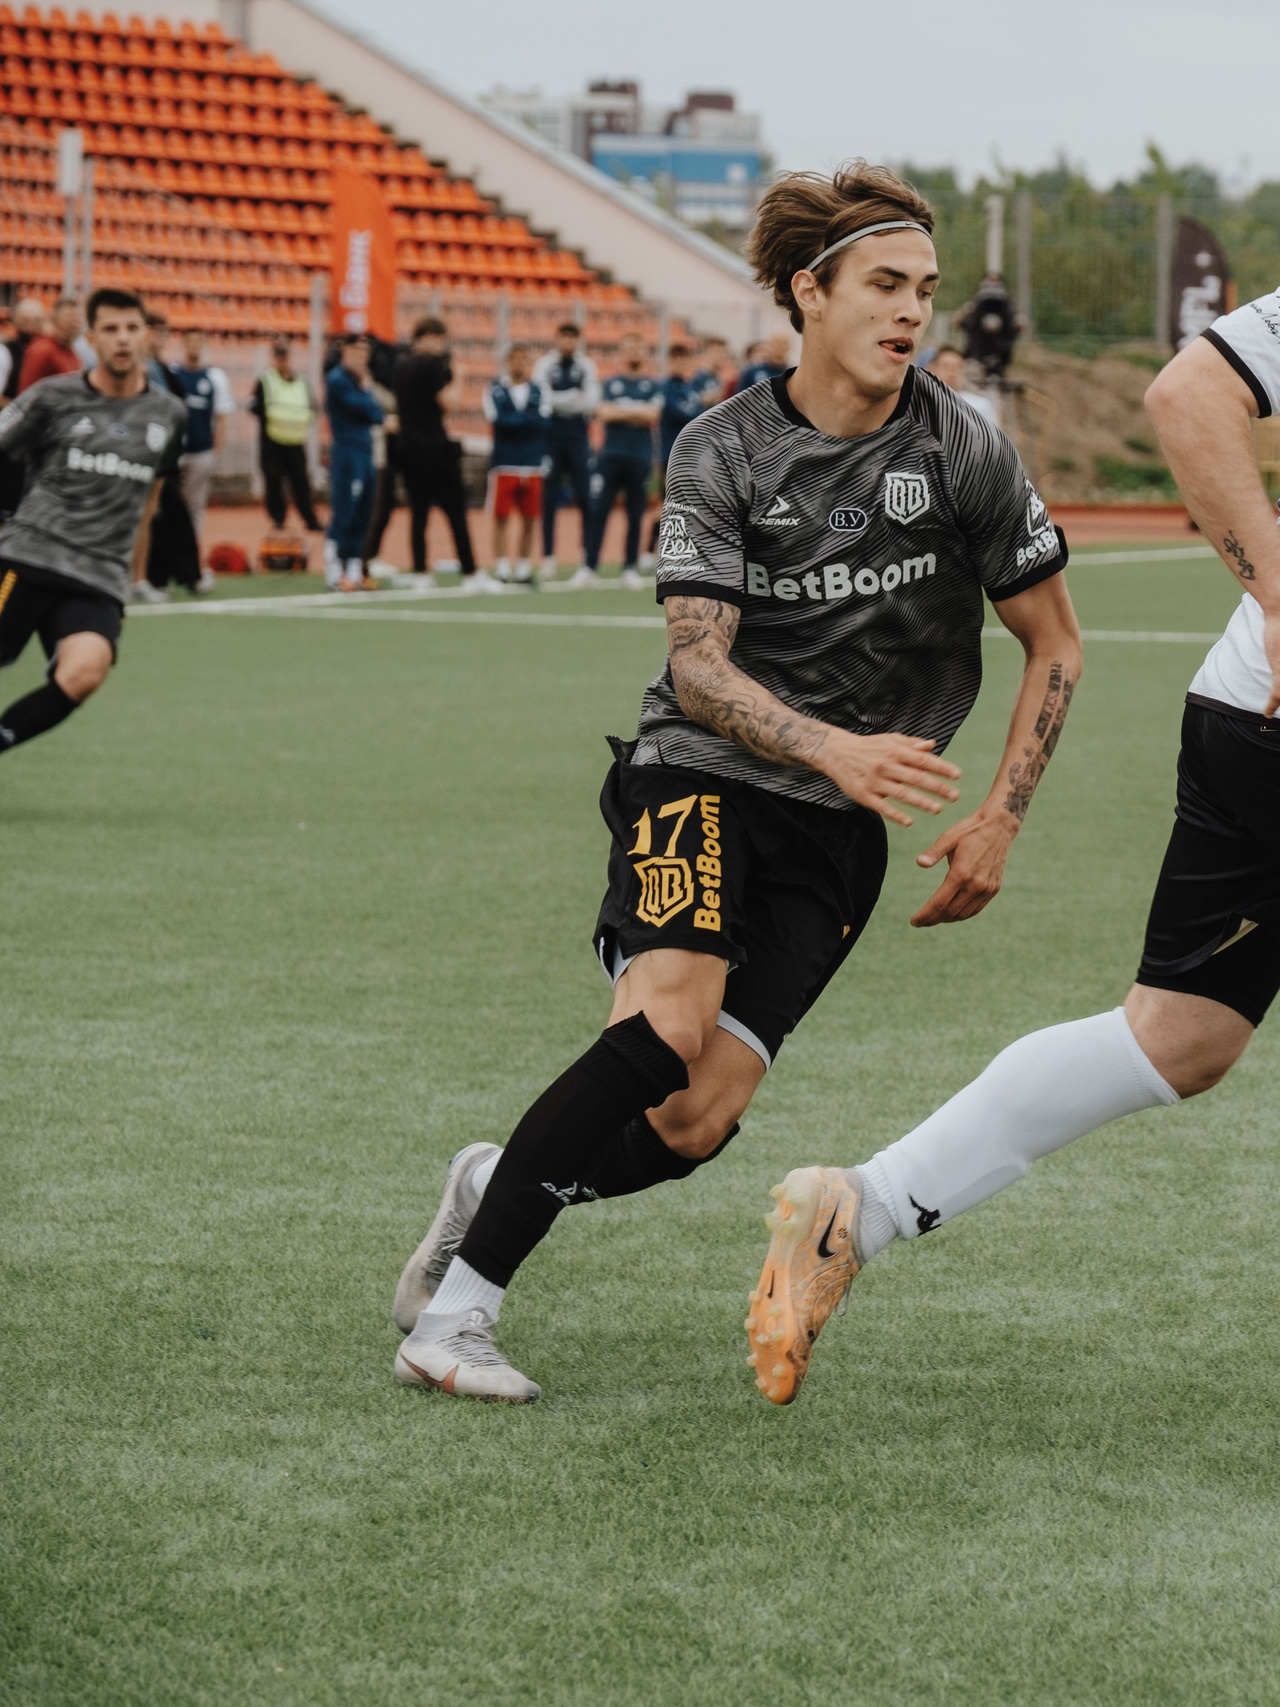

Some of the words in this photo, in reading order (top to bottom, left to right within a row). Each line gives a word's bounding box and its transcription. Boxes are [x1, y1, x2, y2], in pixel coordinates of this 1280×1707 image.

[753, 517, 801, 526] DEMIX
[746, 552, 937, 601] BetBoom
[626, 794, 699, 857] 17
[693, 794, 722, 932] BetBoom
